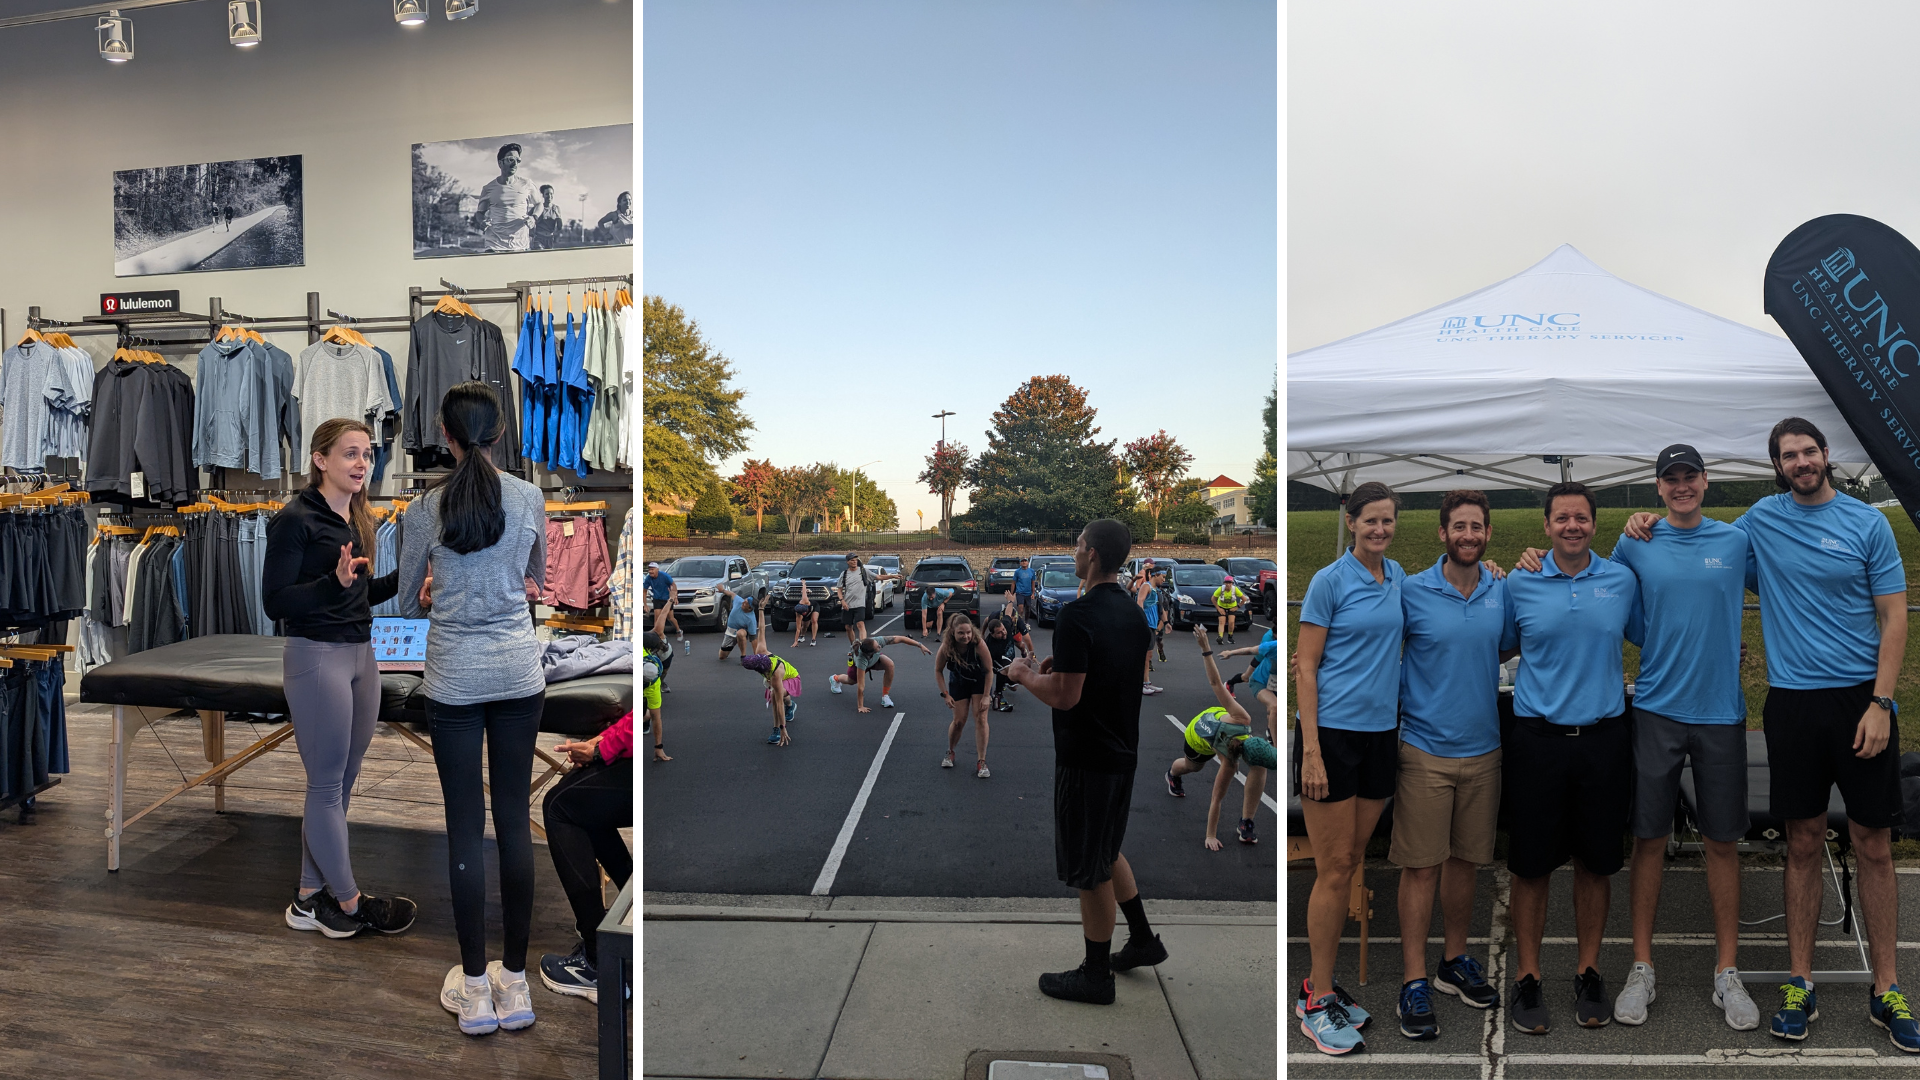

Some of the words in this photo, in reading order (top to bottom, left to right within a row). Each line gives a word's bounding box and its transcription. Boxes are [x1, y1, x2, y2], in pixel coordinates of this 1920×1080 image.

[120, 298, 172, 310] lululemon
[1439, 327, 1519, 335] HEALTH
[1472, 313, 1580, 328] UNC
[1808, 266, 1863, 338] HEALTH
[1862, 343, 1900, 390] CARE
[1843, 267, 1920, 379] UNC
[1792, 280, 1822, 319] UNC
[1820, 321, 1881, 402] THERAPY
